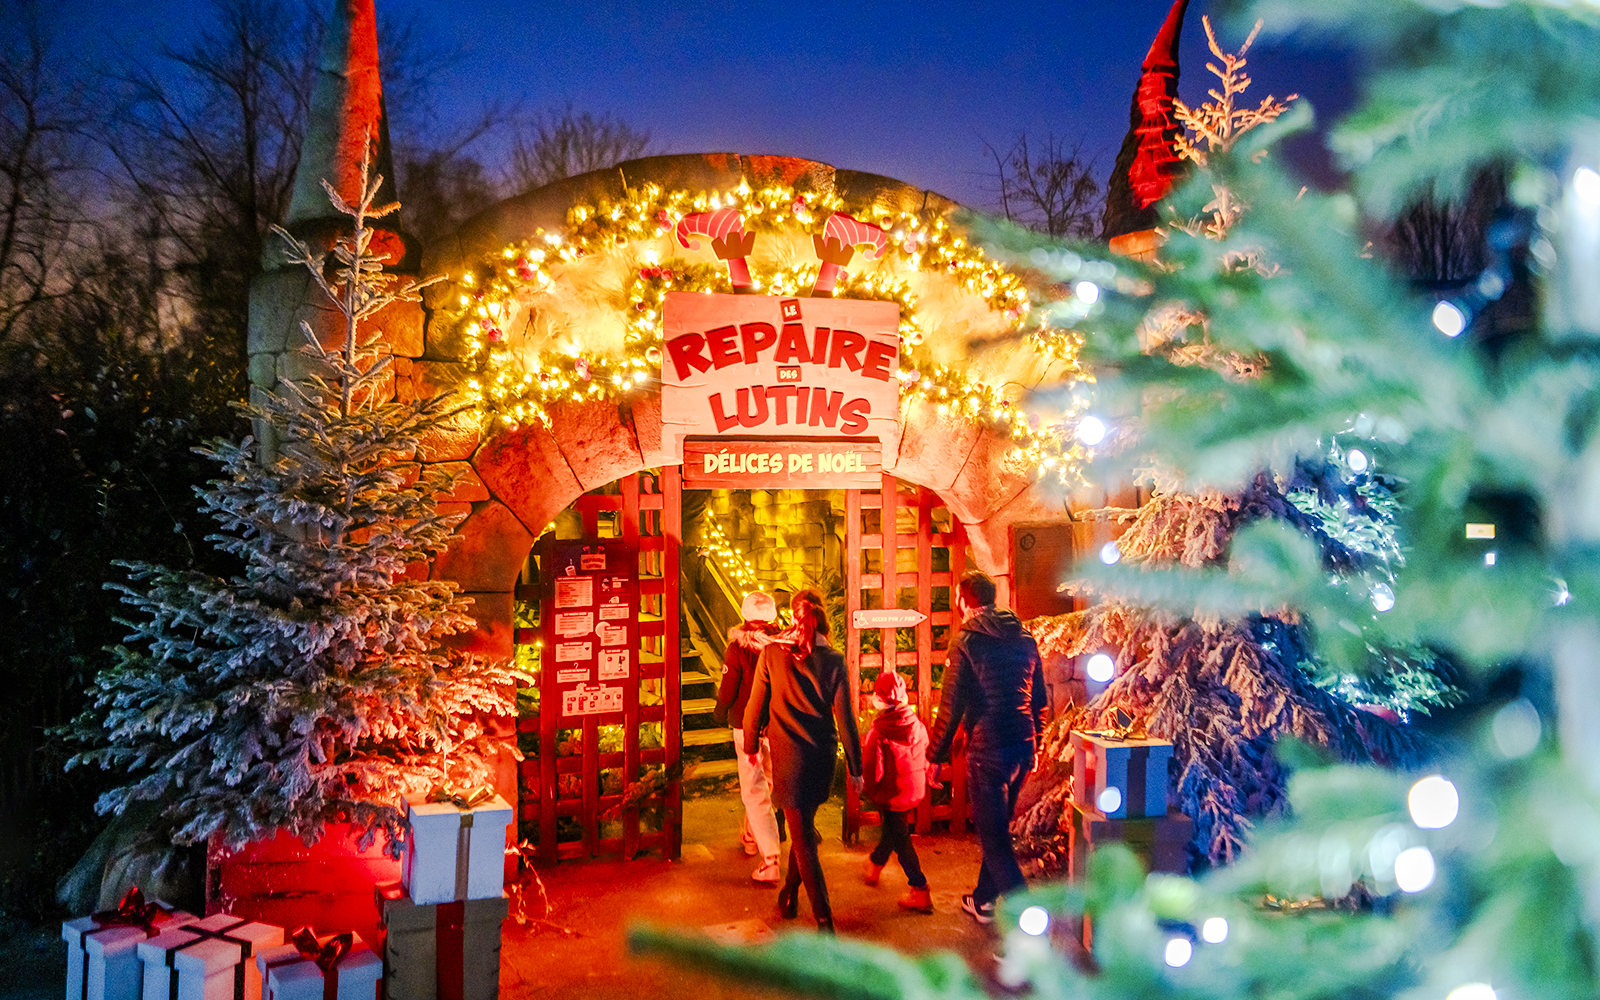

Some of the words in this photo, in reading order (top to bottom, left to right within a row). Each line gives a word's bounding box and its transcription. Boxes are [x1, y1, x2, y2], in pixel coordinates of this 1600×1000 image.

[784, 304, 798, 317] LE
[665, 321, 897, 383] REPAIRE
[780, 369, 798, 380] DES
[708, 384, 872, 435] LUTINS
[704, 448, 784, 474] DÉLICES
[788, 453, 813, 474] DE
[818, 450, 866, 474] NOËL
